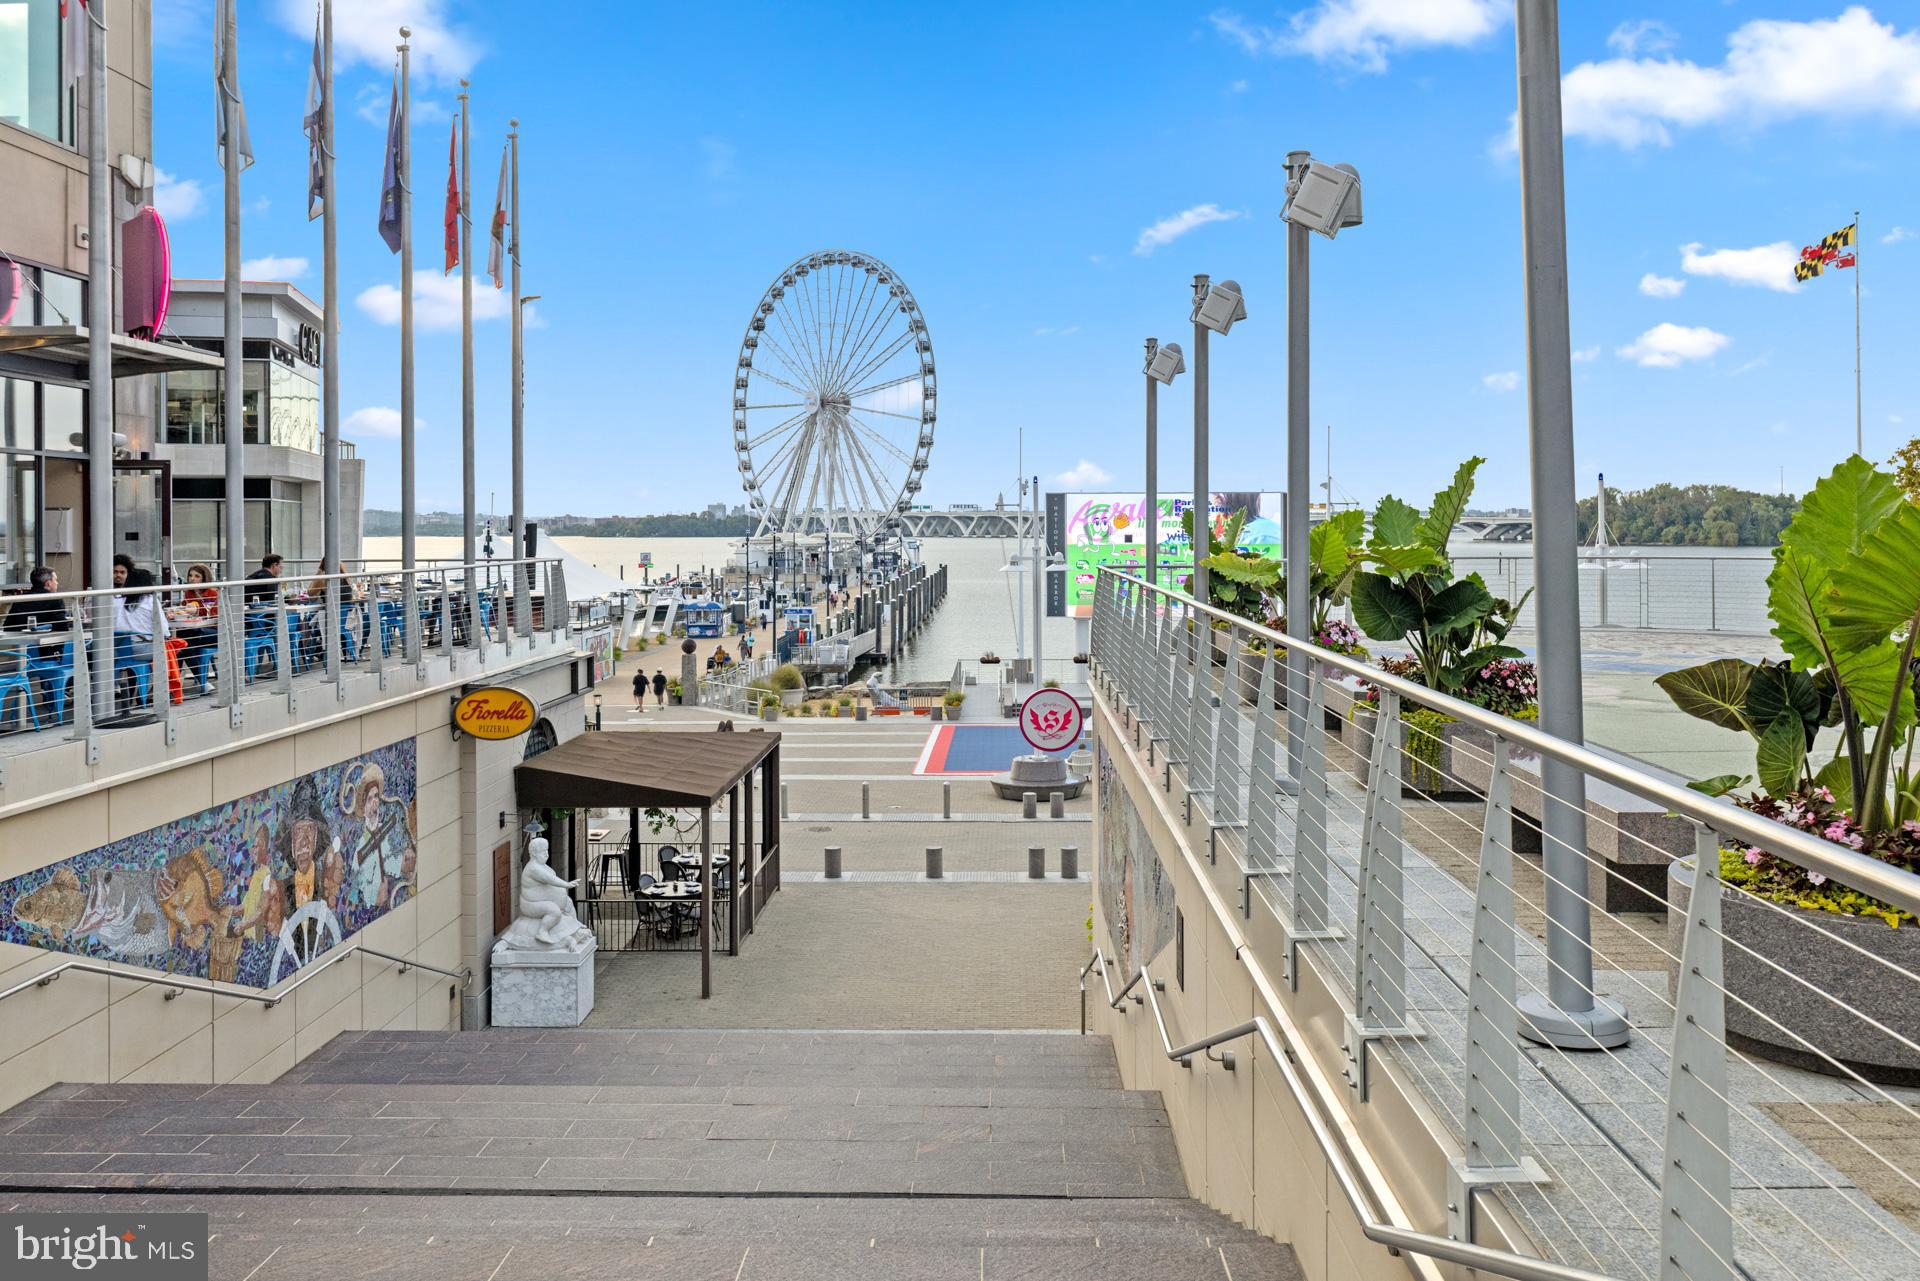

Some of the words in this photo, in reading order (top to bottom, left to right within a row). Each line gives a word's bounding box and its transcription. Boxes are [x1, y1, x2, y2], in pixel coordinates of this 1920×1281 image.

[1174, 498, 1195, 506] Par
[1167, 530, 1192, 542] wit
[460, 699, 528, 721] Fiorella
[478, 724, 510, 733] PIZZERIA
